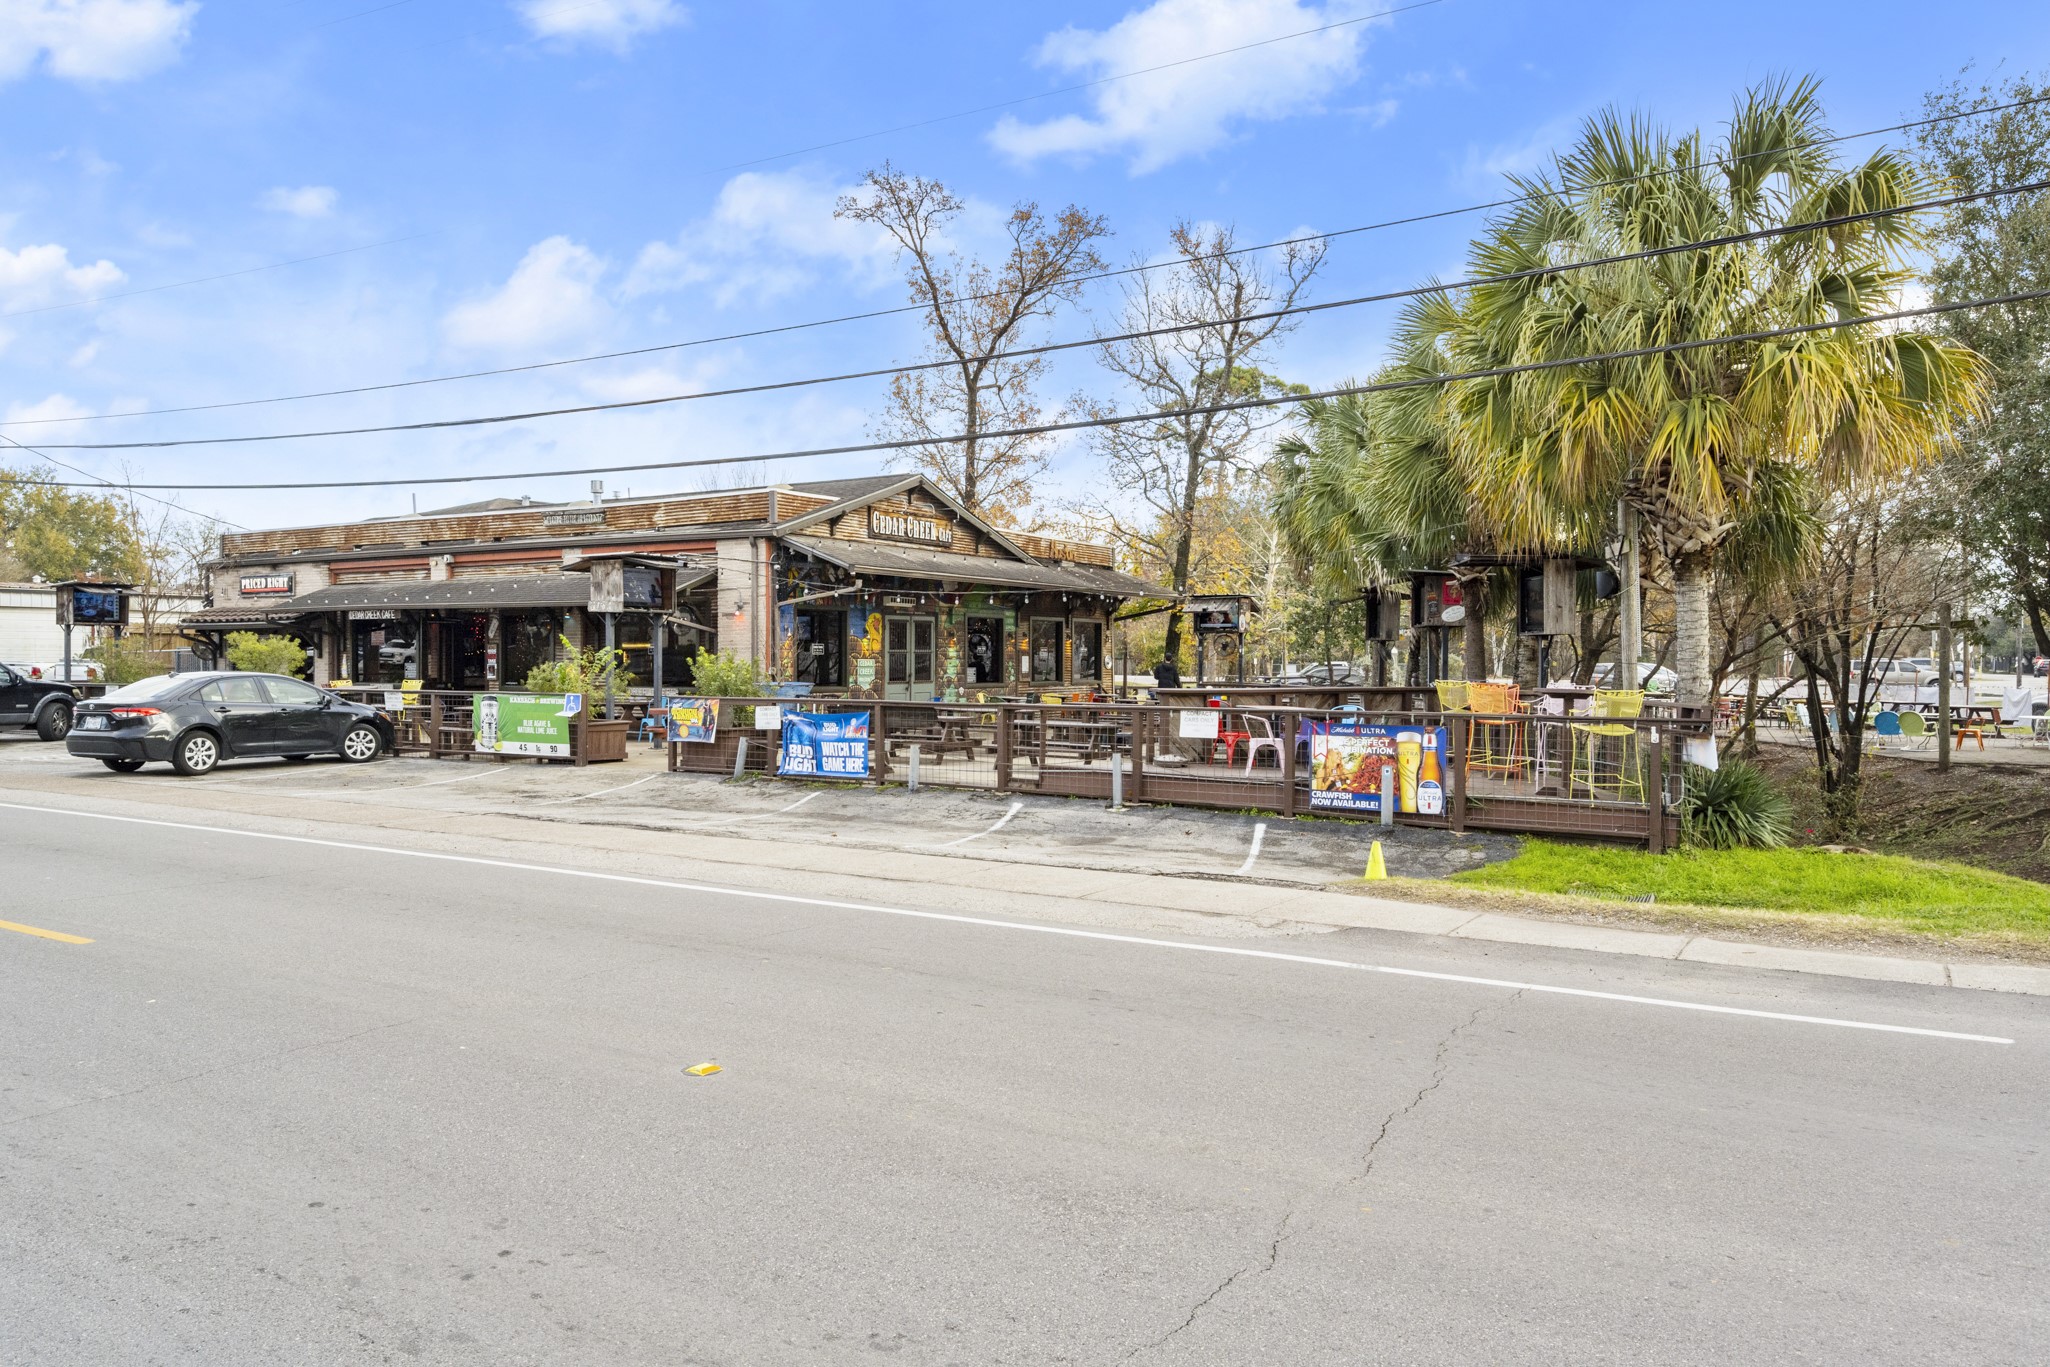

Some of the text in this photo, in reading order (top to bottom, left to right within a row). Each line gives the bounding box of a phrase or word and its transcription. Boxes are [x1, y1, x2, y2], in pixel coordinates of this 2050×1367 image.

[873, 511, 905, 537] CEDAR
[907, 516, 936, 540] CREEK
[241, 577, 288, 589] PRICED RIGHT
[549, 745, 558, 753] 90
[1352, 738, 1390, 747] PERFECT
[789, 744, 814, 758] BUD
[821, 742, 865, 757] WATCH THE
[785, 757, 817, 772] LIGHT
[822, 757, 865, 773] GAME HERE
[1311, 790, 1352, 800] CRAWFISH
[1311, 797, 1379, 809] NOW AVAILABLE!
